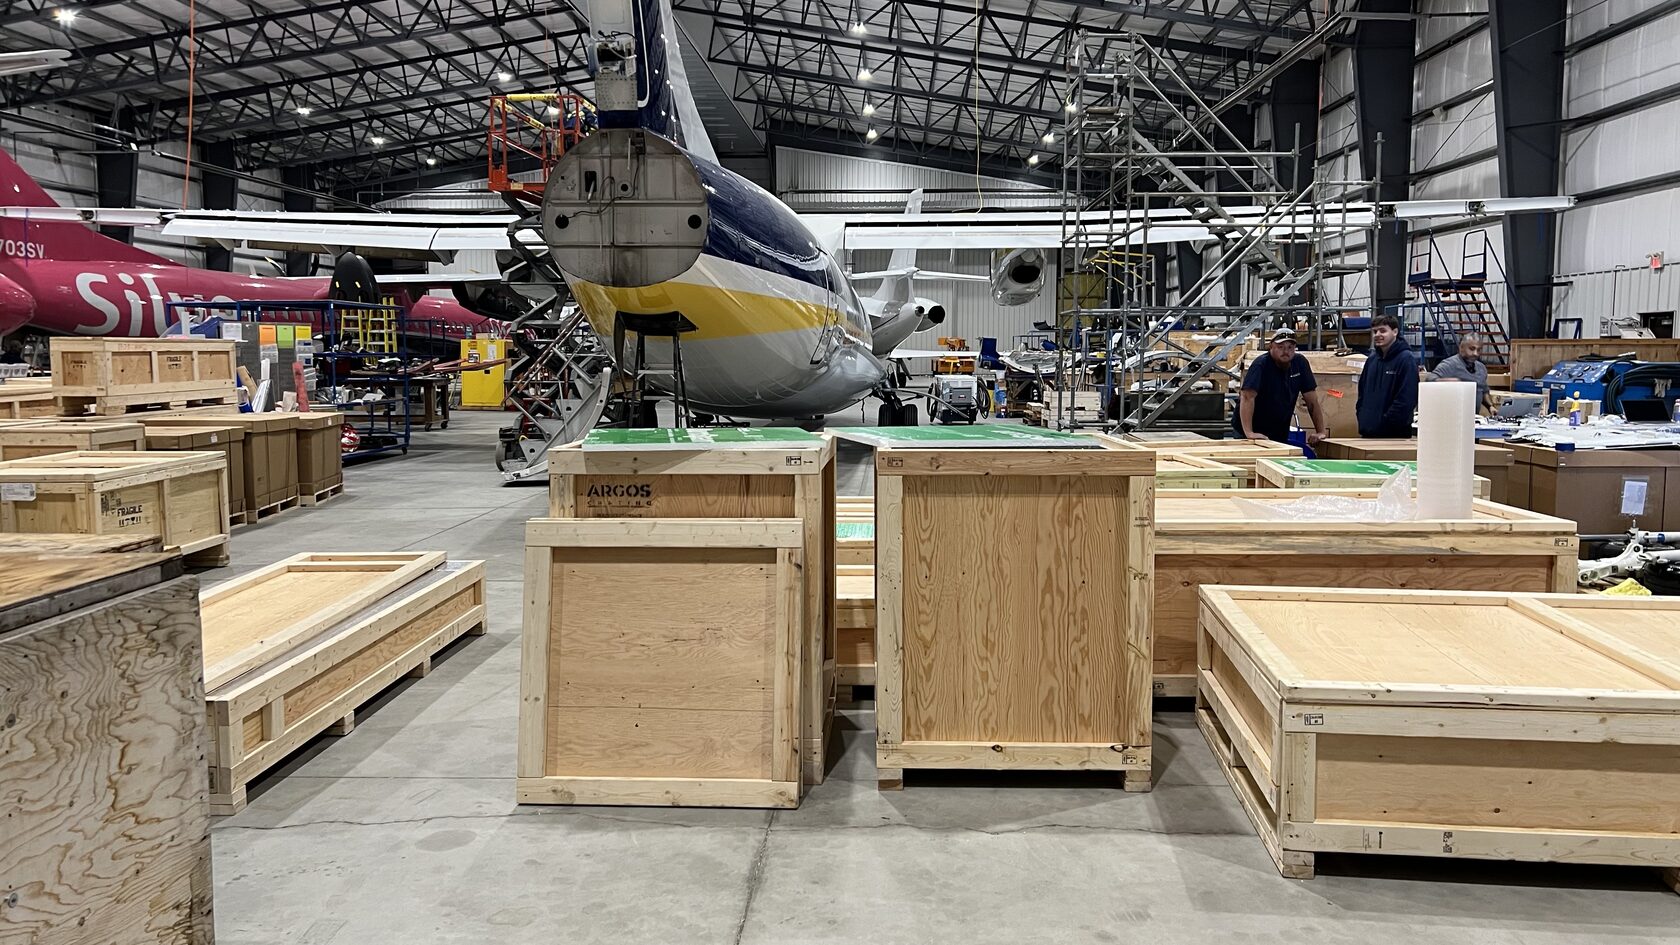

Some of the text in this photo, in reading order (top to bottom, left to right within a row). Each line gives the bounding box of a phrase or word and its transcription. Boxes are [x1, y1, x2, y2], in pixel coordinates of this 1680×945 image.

[73, 272, 262, 337] Silve
[587, 484, 652, 497] ARGOS
[117, 504, 143, 517] FRAGILE
